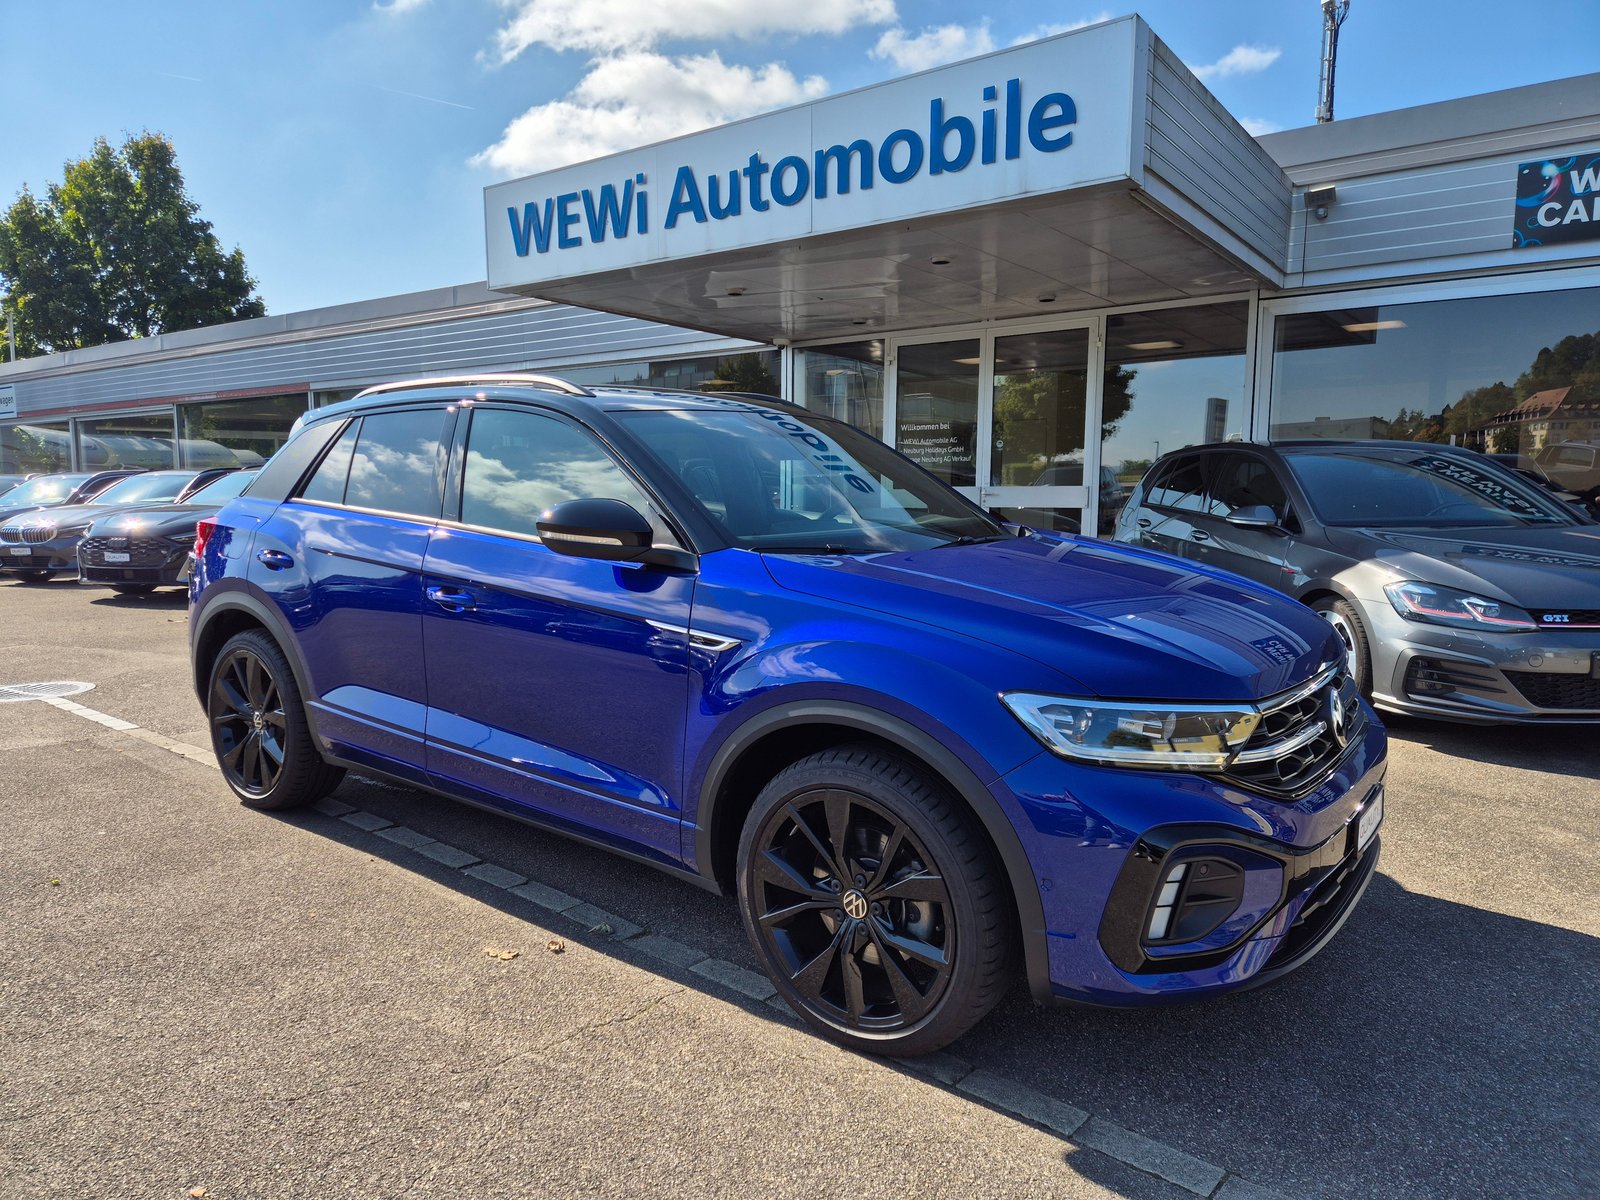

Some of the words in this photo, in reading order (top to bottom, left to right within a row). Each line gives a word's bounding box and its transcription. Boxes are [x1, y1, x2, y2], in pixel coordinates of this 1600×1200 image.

[506, 172, 648, 257] WEWi
[664, 78, 1077, 229] Automobile
[900, 423, 939, 432] Willkommen
[939, 421, 950, 431] bei
[920, 437, 949, 445] Automobile
[903, 447, 924, 456] Neuburg
[925, 446, 947, 455] Holidays
[921, 456, 943, 464] Neuburg
[1542, 614, 1570, 623] GTI
